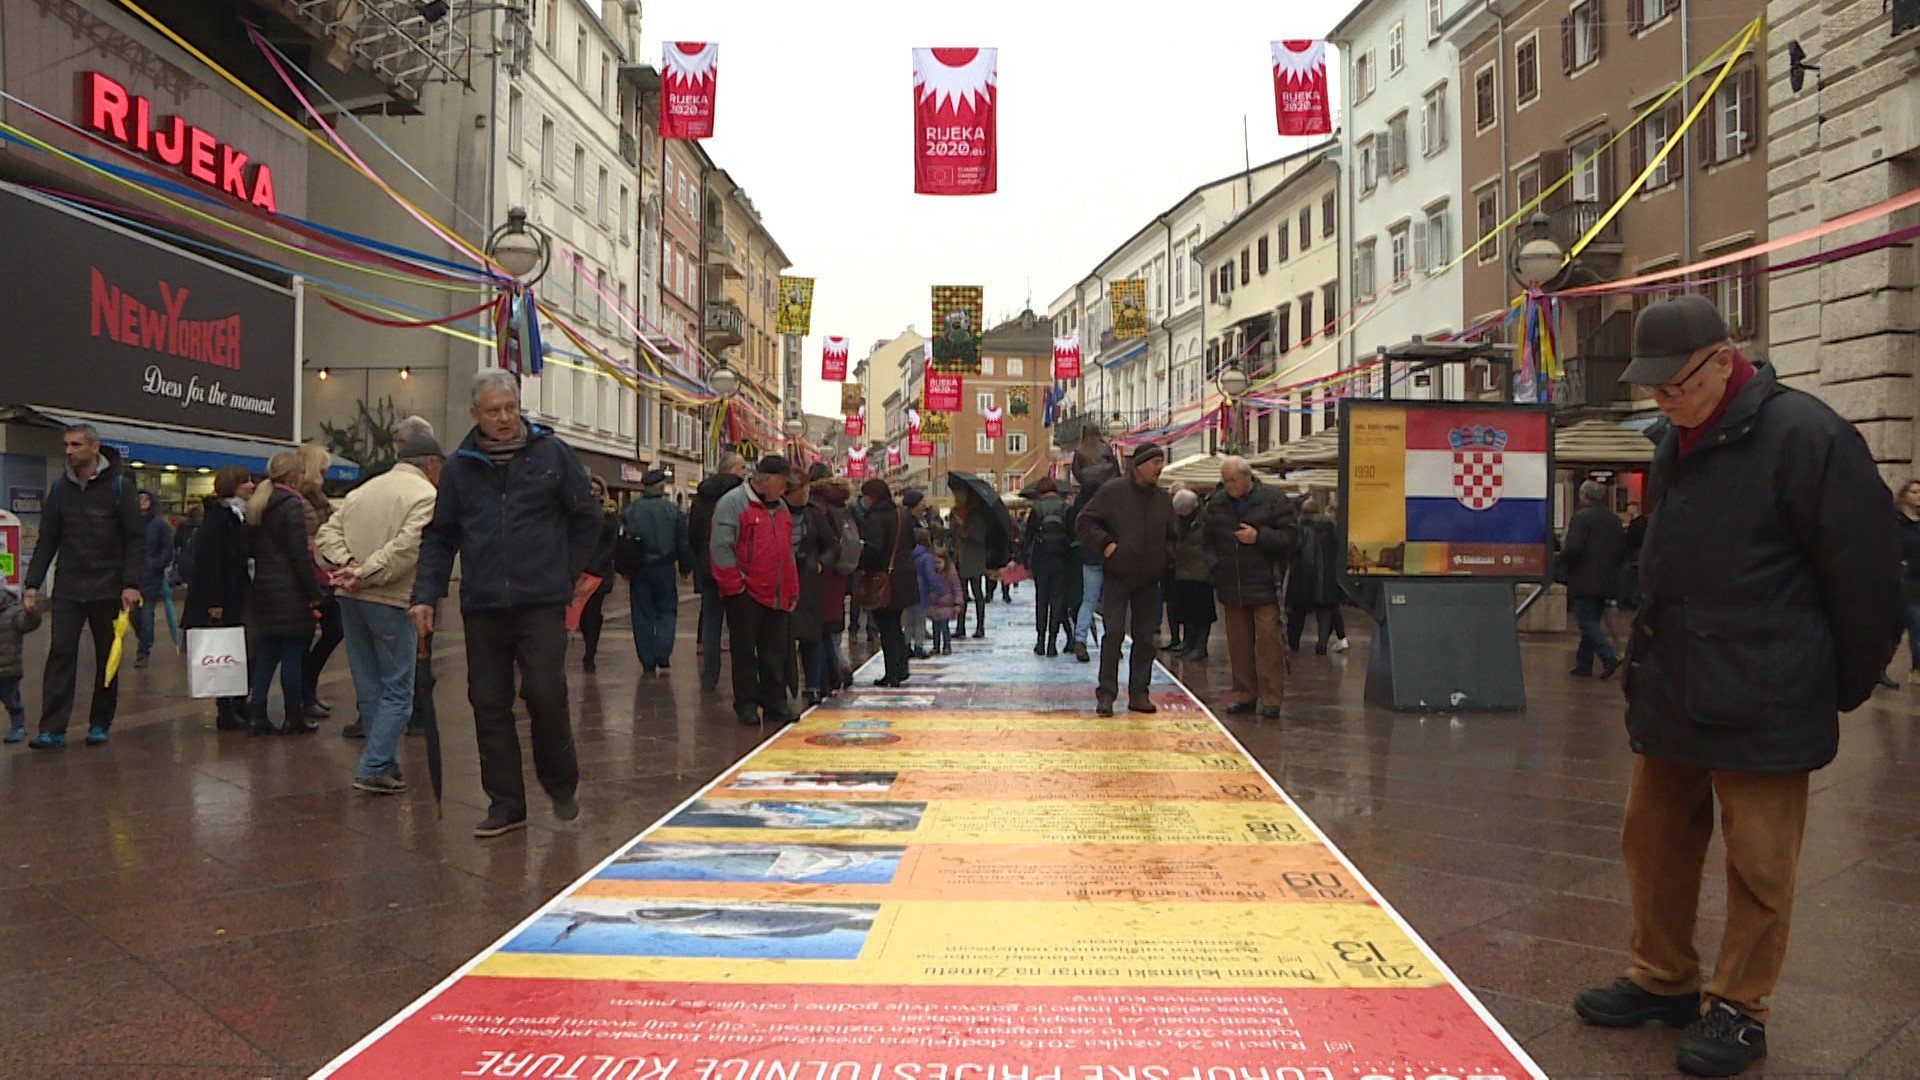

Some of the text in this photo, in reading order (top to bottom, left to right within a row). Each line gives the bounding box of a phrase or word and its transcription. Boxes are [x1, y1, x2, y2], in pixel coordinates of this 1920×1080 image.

[91, 72, 276, 213] RIJEKA
[926, 127, 986, 140] RIJEKA
[142, 365, 182, 395] Dress
[182, 375, 204, 408] for
[208, 381, 228, 406] the
[1332, 940, 1386, 964] 13
[461, 1051, 679, 1080] KULTURE
